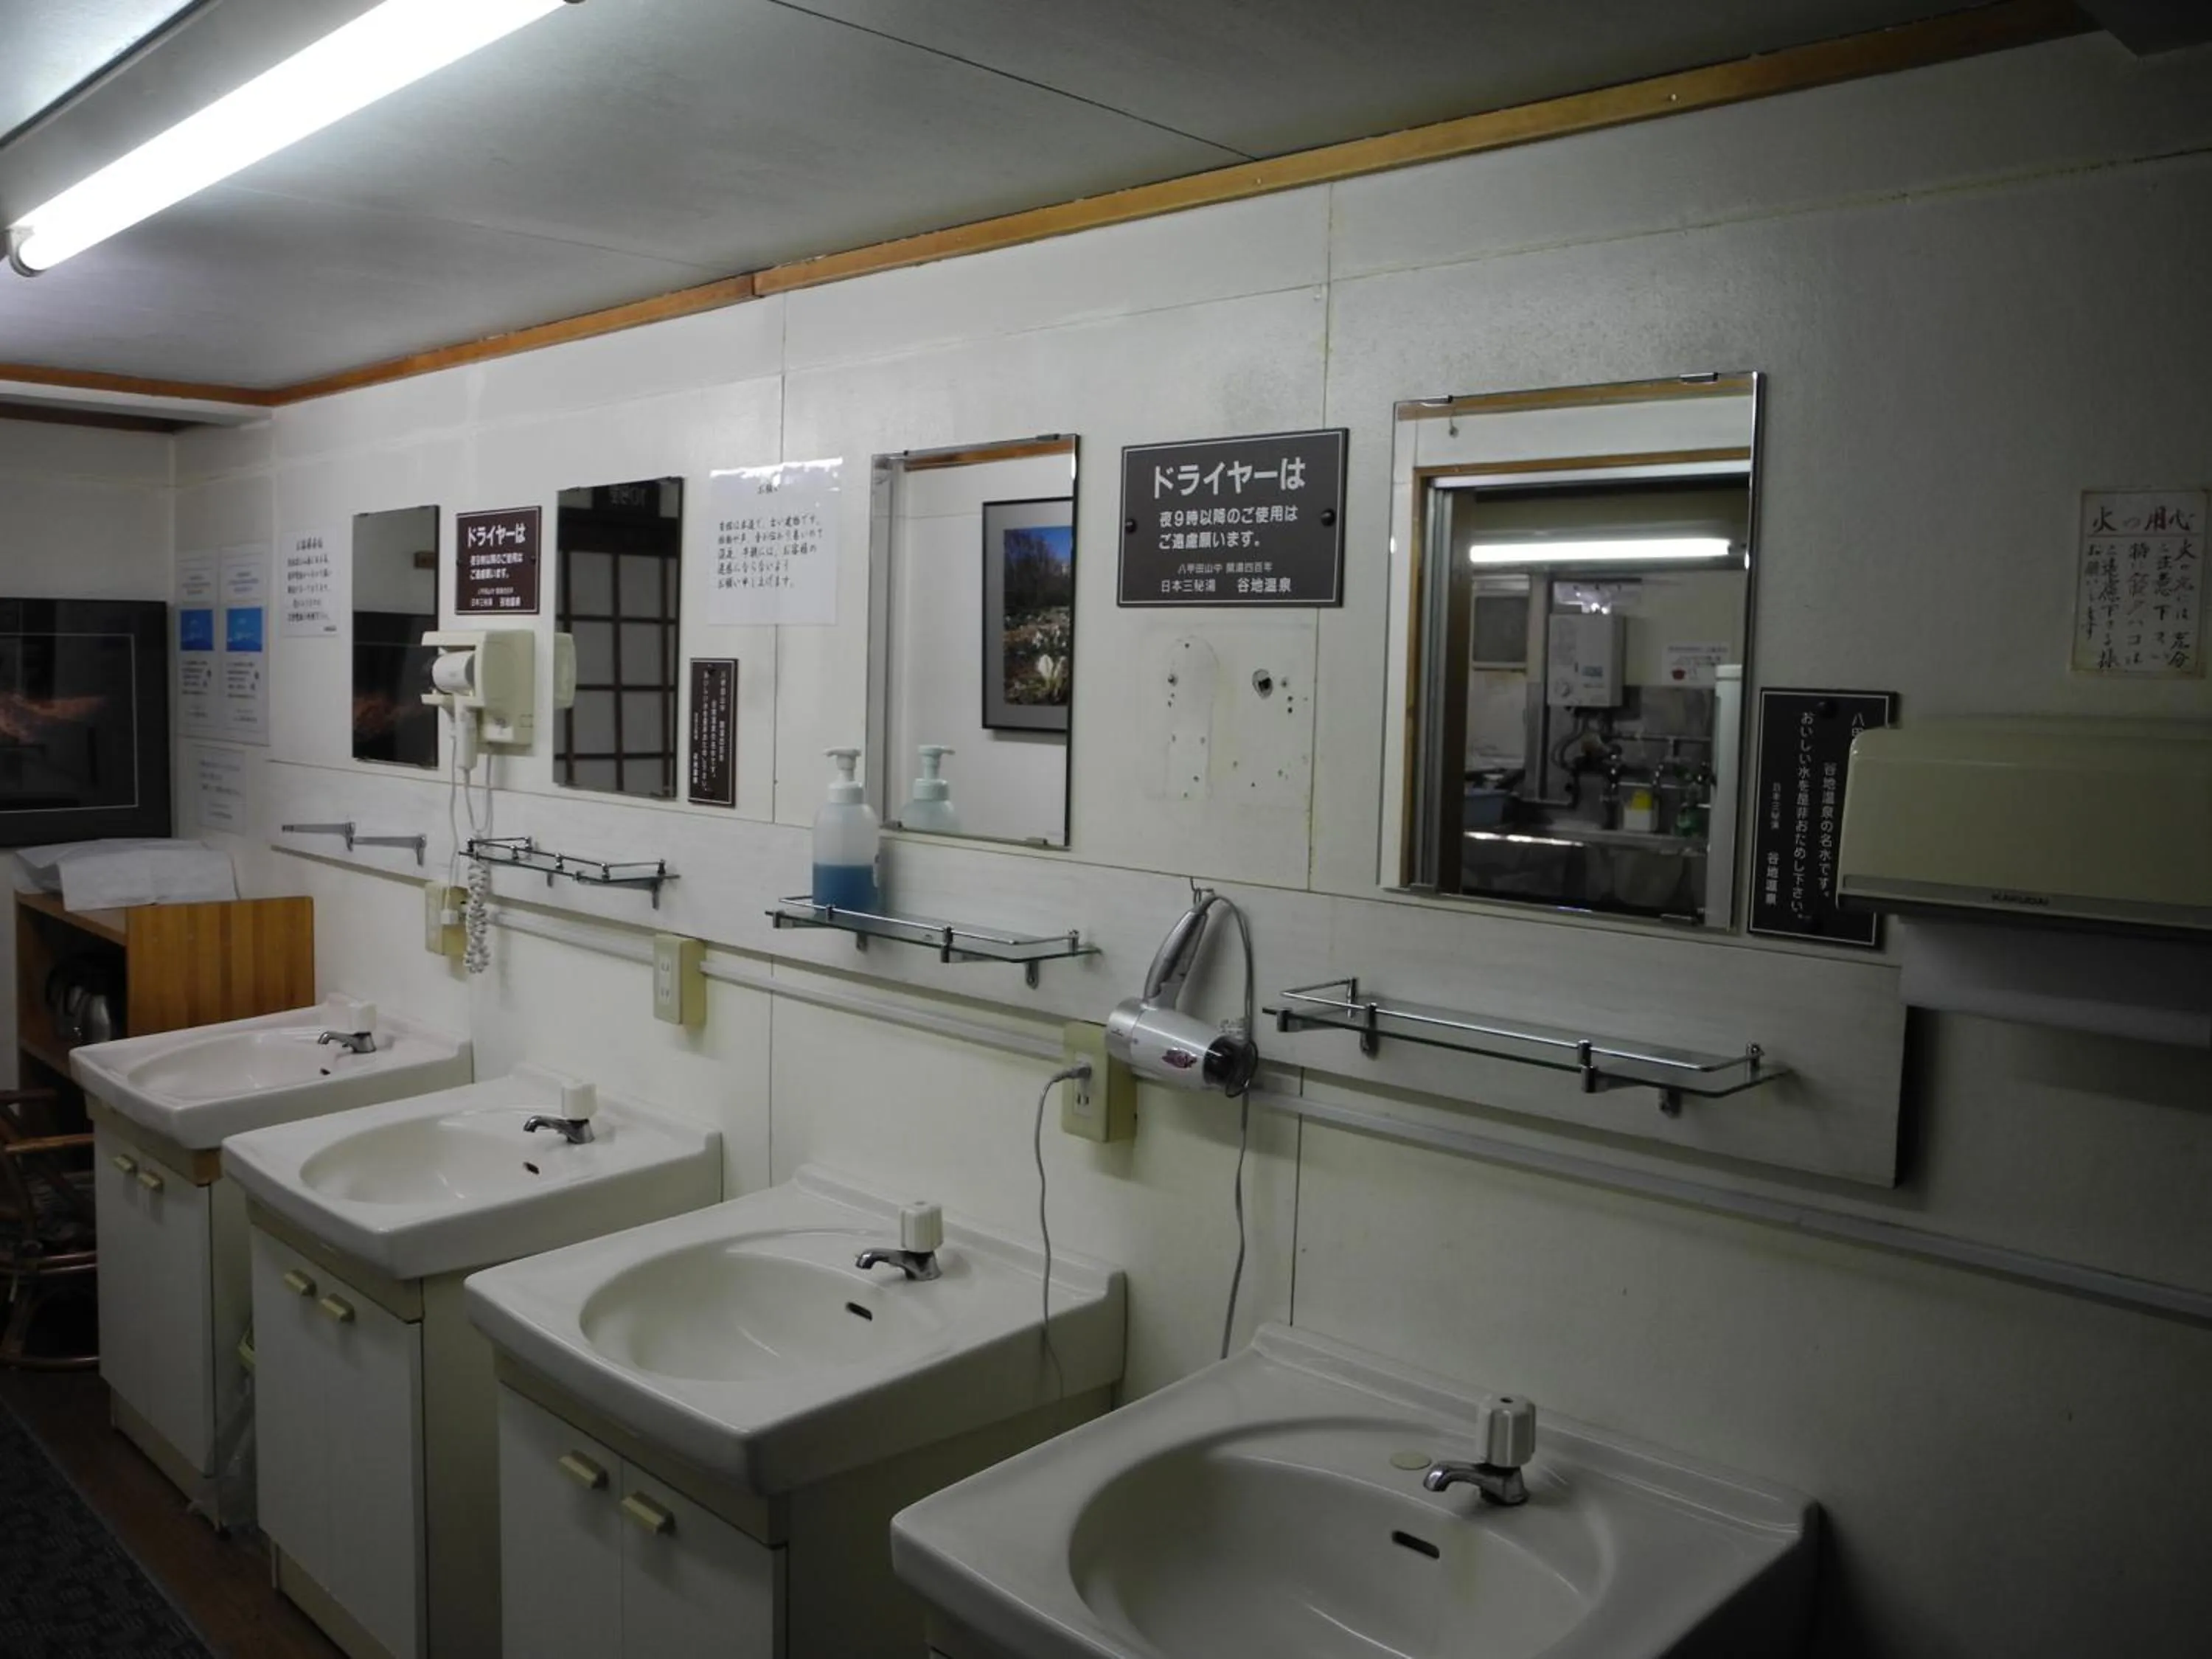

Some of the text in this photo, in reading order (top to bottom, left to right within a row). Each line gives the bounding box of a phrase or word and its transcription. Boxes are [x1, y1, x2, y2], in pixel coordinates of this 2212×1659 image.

[1154, 456, 1306, 499] ドライヤーは
[1159, 504, 1298, 529] 夜9時以降のご使用は
[2093, 505, 2197, 533] 火の用心
[467, 523, 526, 549] ドライヤーは
[1158, 530, 1260, 549] ご遠慮願います。
[1237, 577, 1291, 593] 谷地温泉
